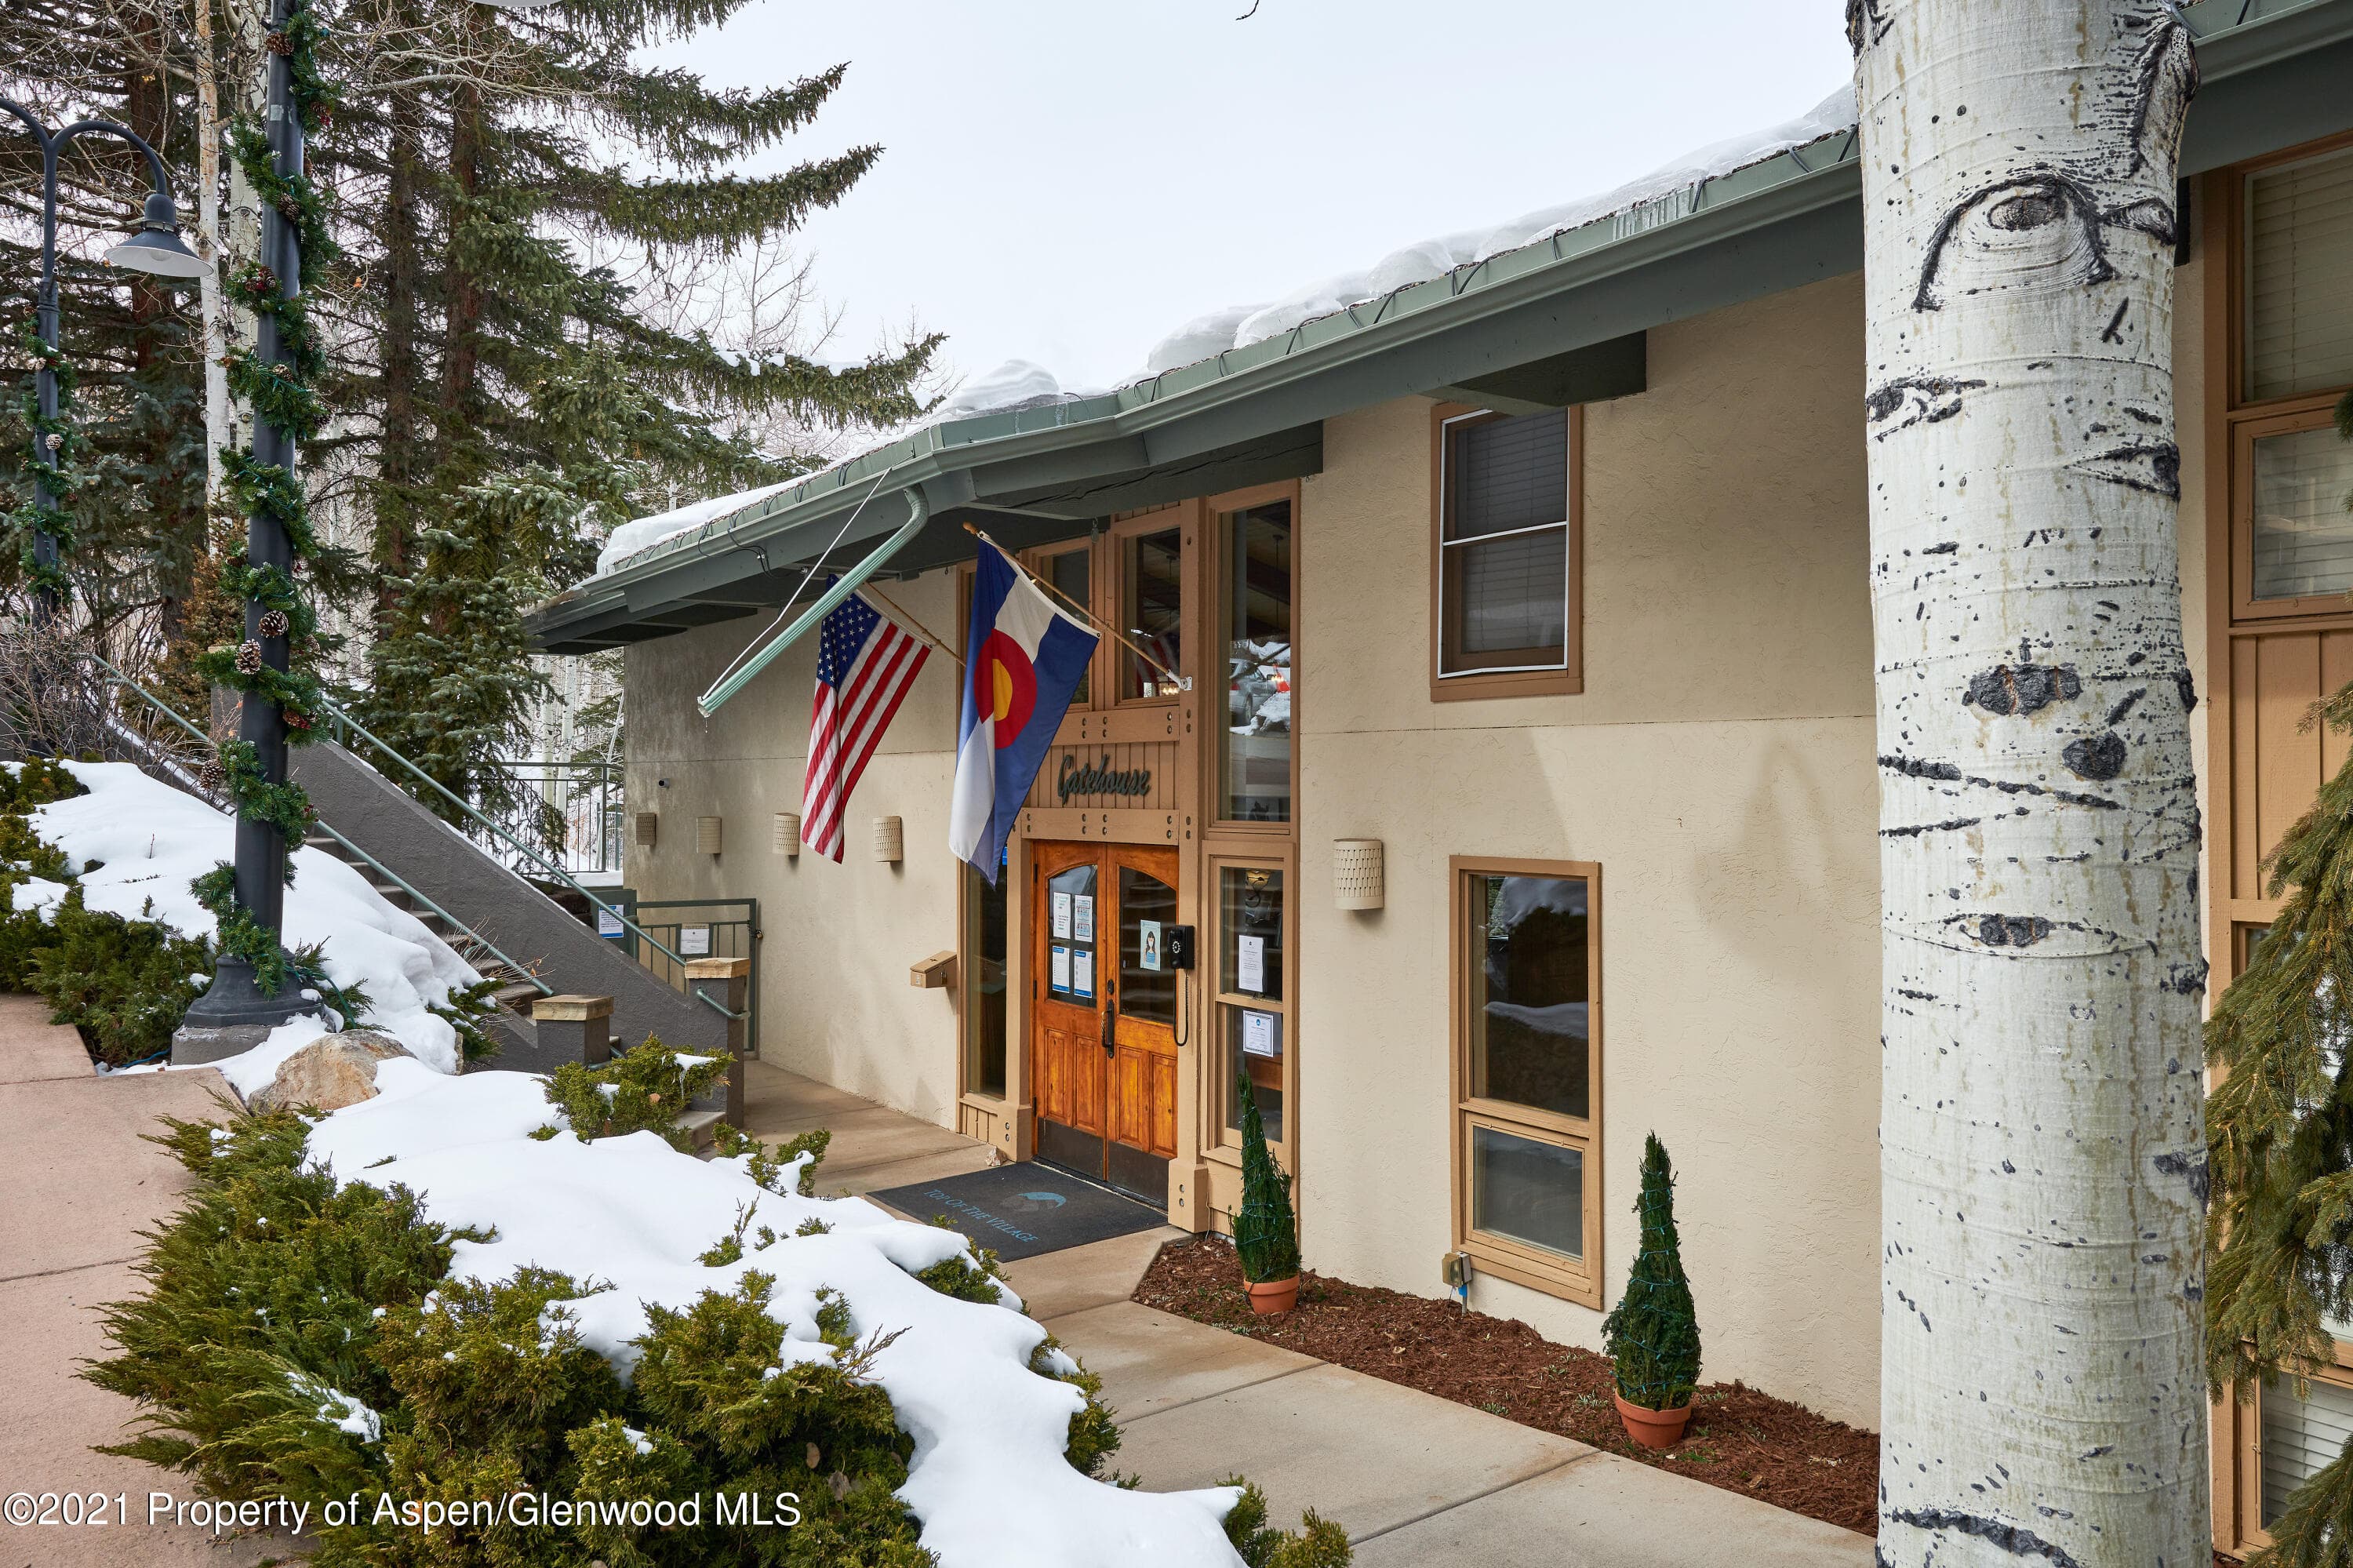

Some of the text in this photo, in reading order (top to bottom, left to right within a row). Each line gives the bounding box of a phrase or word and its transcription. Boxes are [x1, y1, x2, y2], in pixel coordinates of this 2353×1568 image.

[1057, 754, 1151, 805] Gatehouse
[923, 1189, 1039, 1242] TOP OF THE VILLAGE
